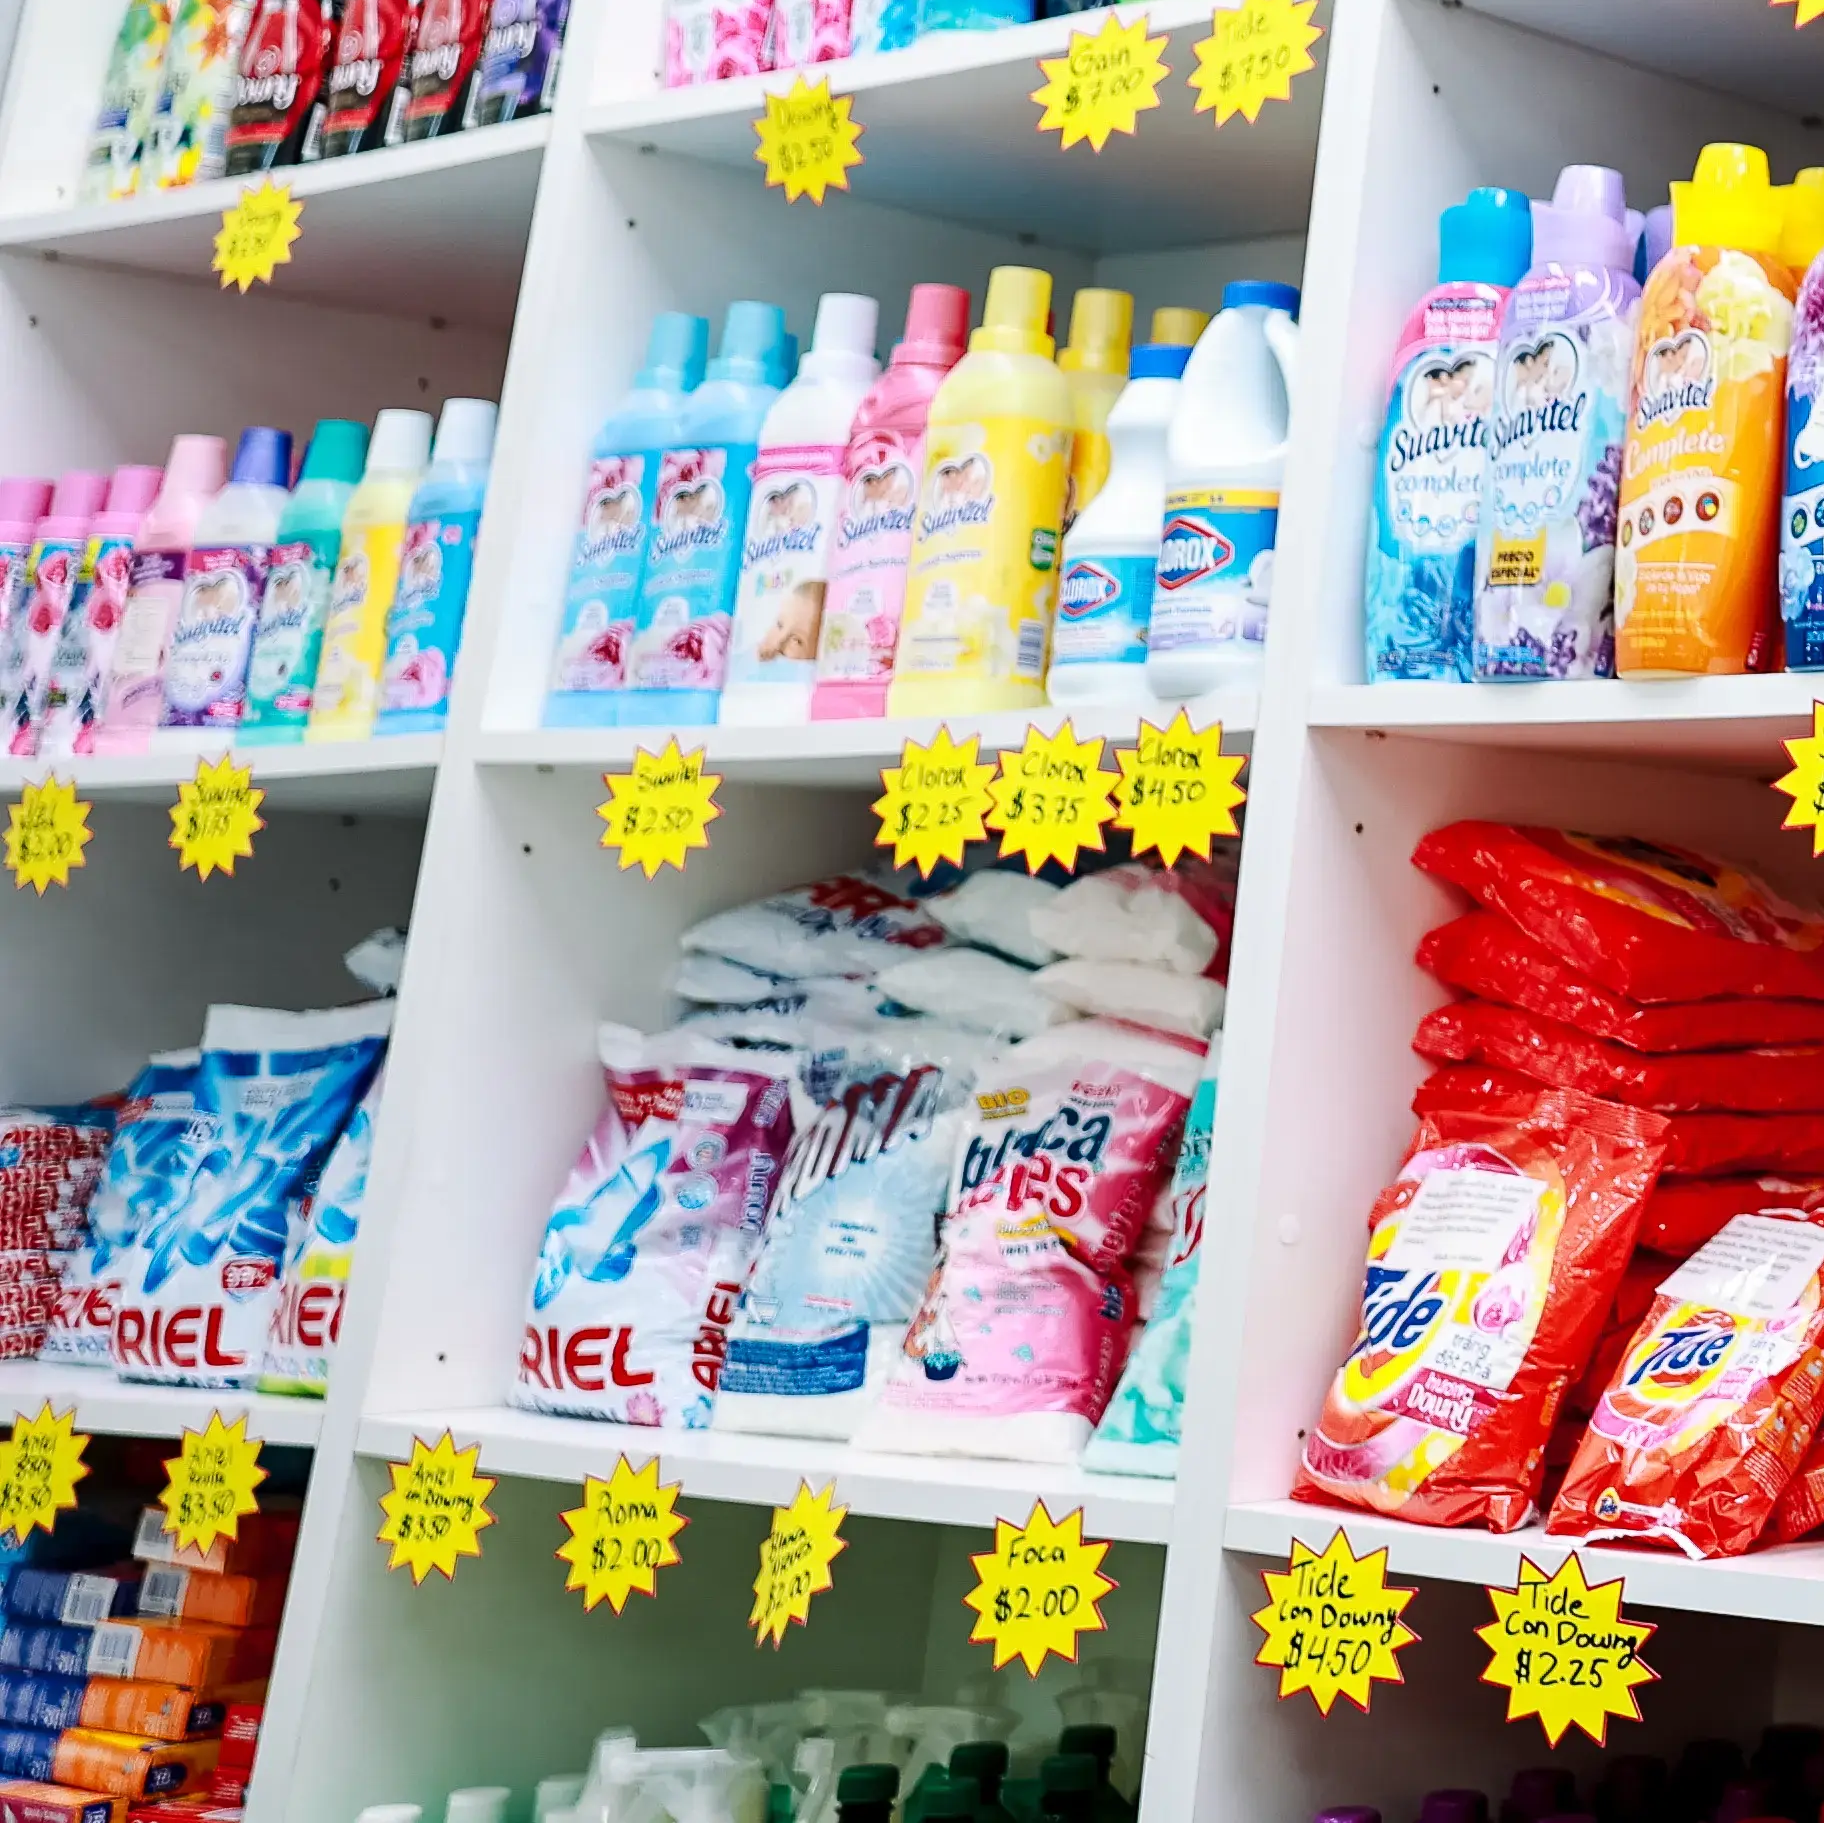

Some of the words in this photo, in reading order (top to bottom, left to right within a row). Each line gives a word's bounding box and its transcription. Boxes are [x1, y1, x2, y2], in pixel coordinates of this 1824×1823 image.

[1069, 44, 1130, 78] Gain
[1636, 383, 1712, 428] Suavitel
[1021, 757, 1086, 786] Clorox
[1136, 741, 1202, 772] Clorox
[899, 765, 968, 792] Clorox
[1130, 778, 1206, 806] $4.50
[622, 808, 694, 834] $2.50
[894, 801, 970, 834] $2.25
[1005, 791, 1080, 824] $3.75
[1625, 1326, 1736, 1386] Tide
[597, 1489, 658, 1526] Roma
[591, 1538, 662, 1575] $2.00
[1007, 1541, 1067, 1566] Foca
[1291, 1559, 1354, 1599] Tide
[993, 1586, 1080, 1624] $2.00
[1520, 1580, 1590, 1619] Tide
[1321, 1603, 1398, 1643] Downy
[1505, 1610, 1548, 1636] Con
[1558, 1621, 1637, 1668] Downy
[1284, 1631, 1371, 1676] $4.50
[1515, 1648, 1608, 1686] $2.25
